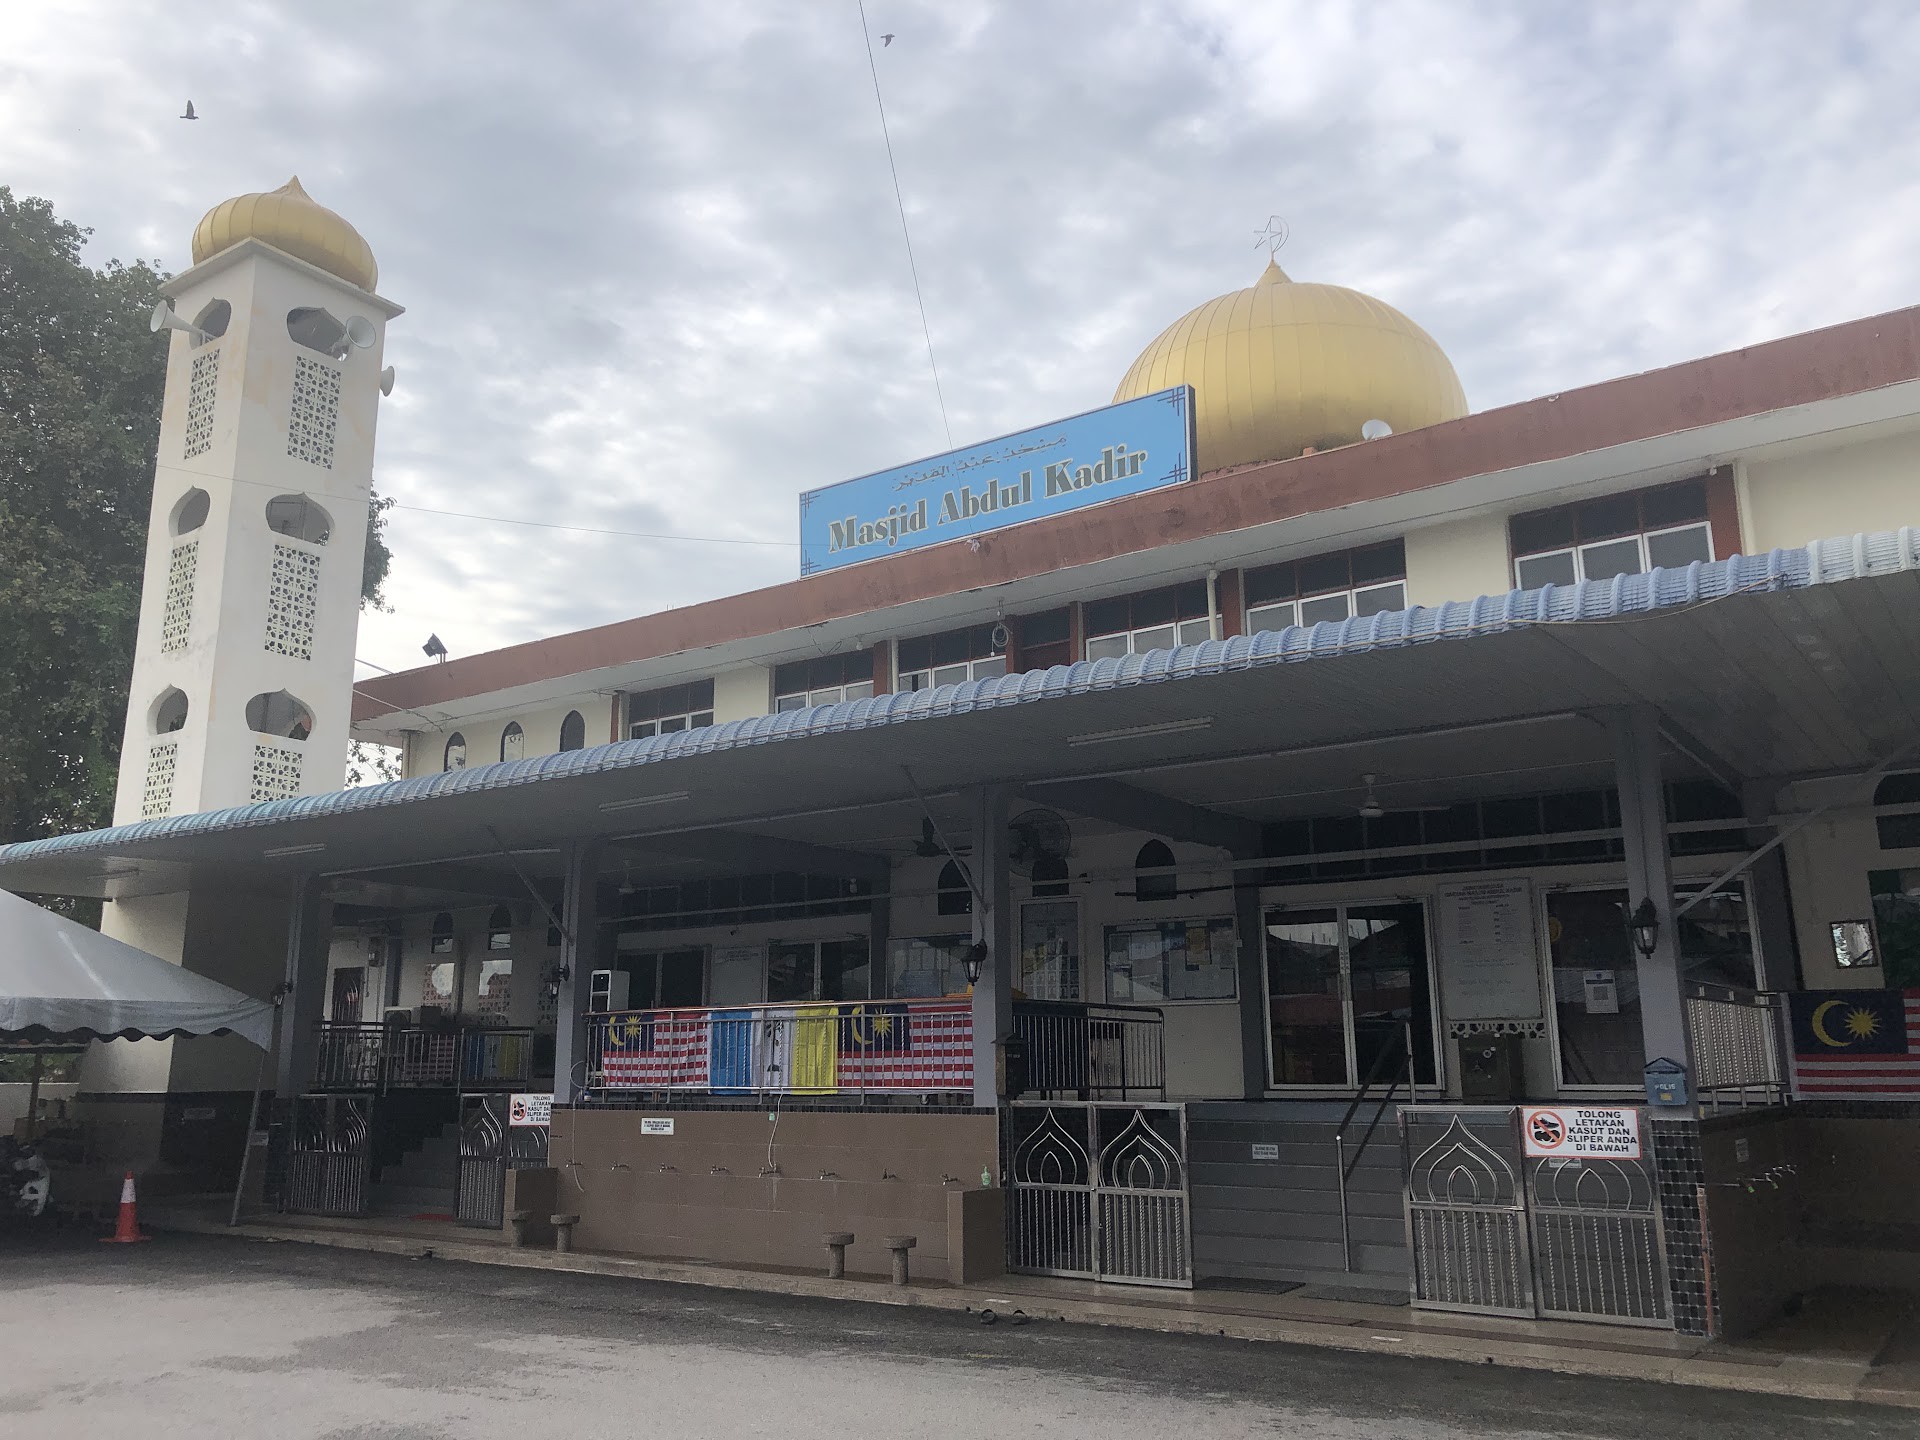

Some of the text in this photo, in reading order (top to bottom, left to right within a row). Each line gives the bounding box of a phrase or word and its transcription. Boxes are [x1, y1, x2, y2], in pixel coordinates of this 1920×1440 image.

[828, 443, 1149, 555] Masjid Abdul Kadir
[1577, 1110, 1621, 1118] TOLONG
[1575, 1119, 1625, 1127] LETAKAN
[1568, 1127, 1604, 1135] KASUT
[1567, 1135, 1638, 1144] SLIPER ANDA
[1590, 1144, 1629, 1152] BAWAH
